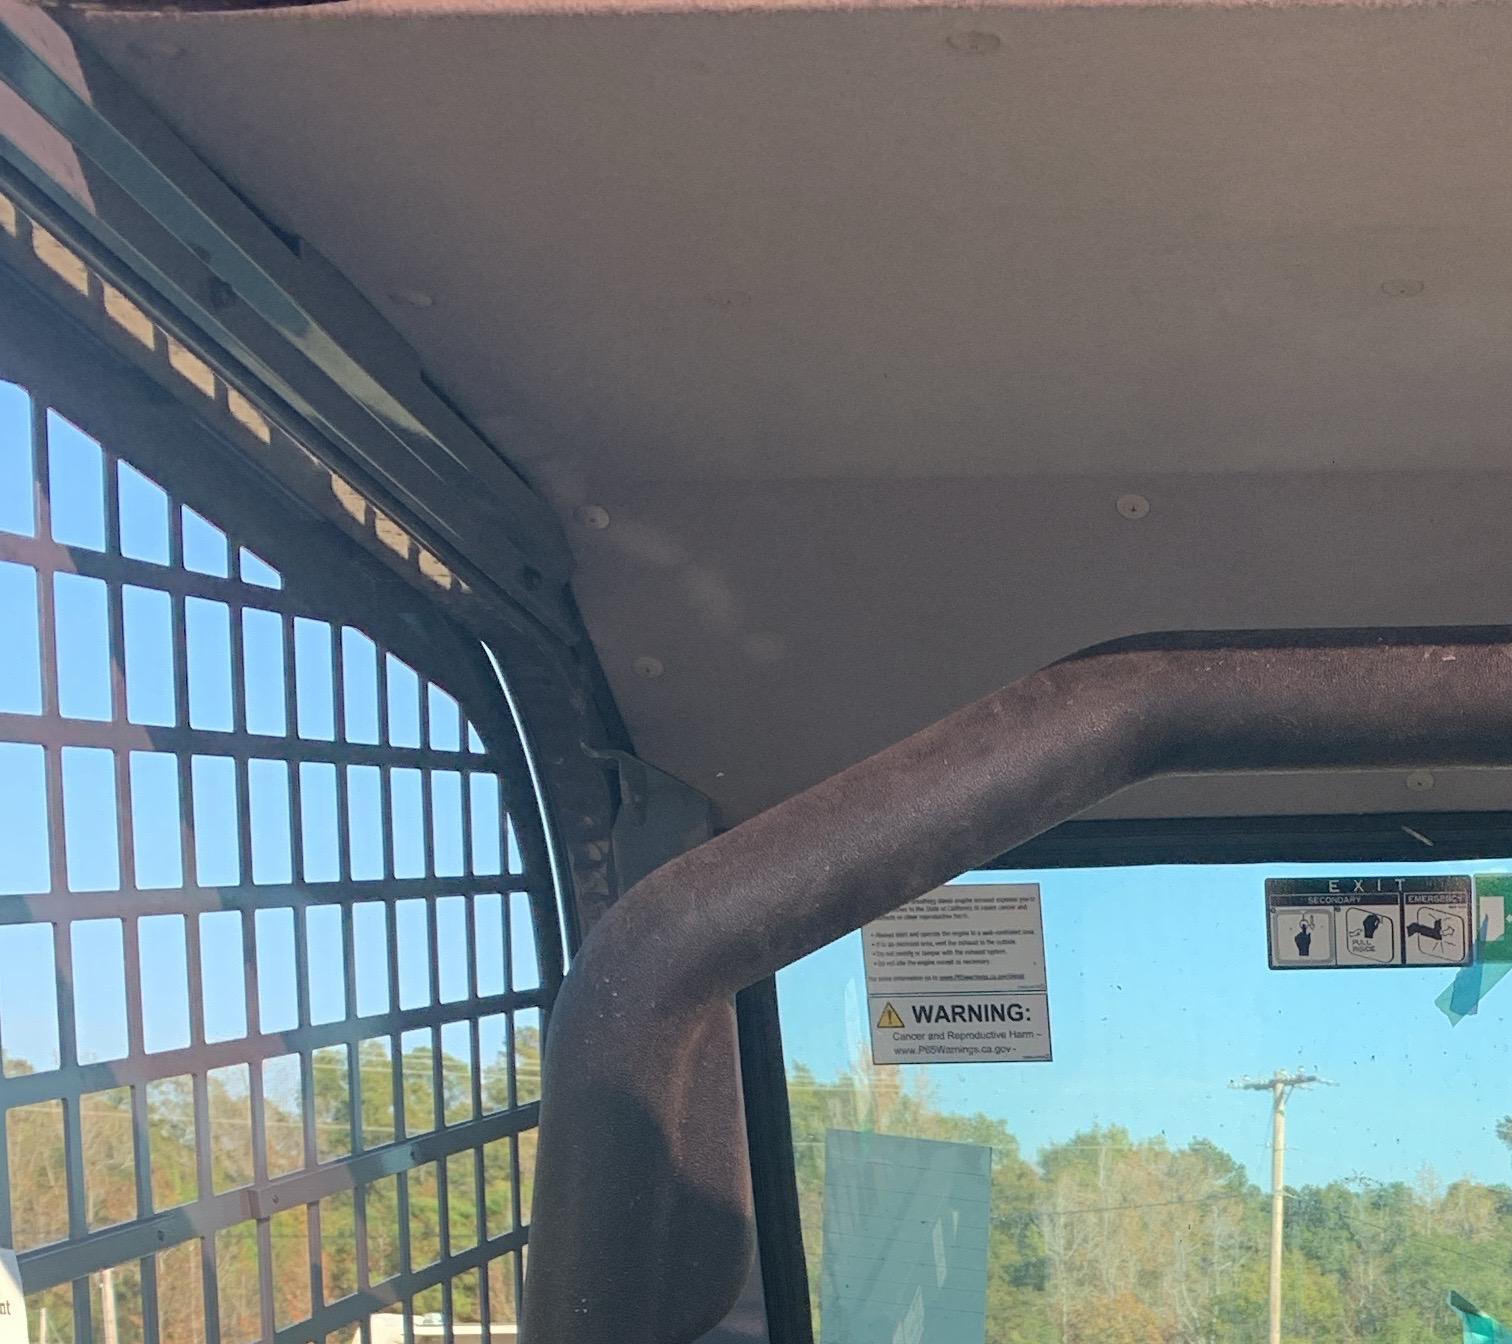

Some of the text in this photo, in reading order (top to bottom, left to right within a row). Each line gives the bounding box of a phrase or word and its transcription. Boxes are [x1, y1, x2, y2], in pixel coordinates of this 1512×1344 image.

[1328, 877, 1406, 892] EXIT
[1307, 896, 1361, 905] SECONDARY
[912, 1003, 1031, 1024] WARNING:
[892, 1030, 1034, 1042] Cancer and Reproductive Harm
